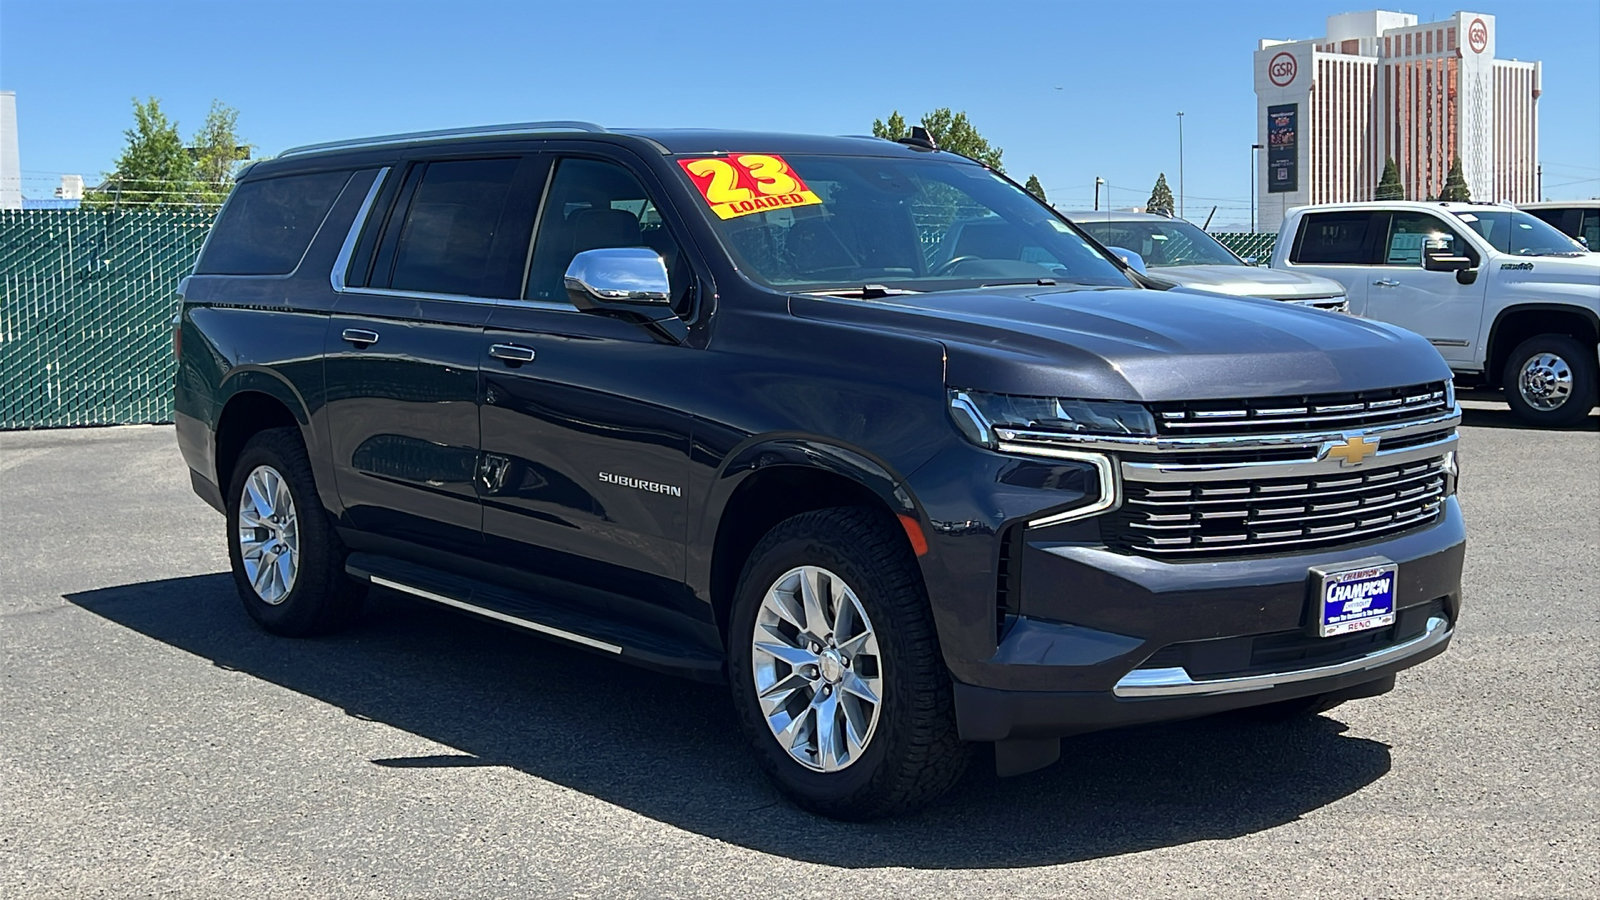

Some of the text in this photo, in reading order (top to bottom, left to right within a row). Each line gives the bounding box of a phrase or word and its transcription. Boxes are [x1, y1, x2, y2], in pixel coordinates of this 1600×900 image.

[1272, 61, 1293, 77] GSR
[687, 154, 801, 204] 23
[729, 193, 804, 214] LOADED
[599, 471, 681, 497] SUBURBAN
[1326, 578, 1390, 603] CHAMPION
[1348, 620, 1371, 631] RENO
